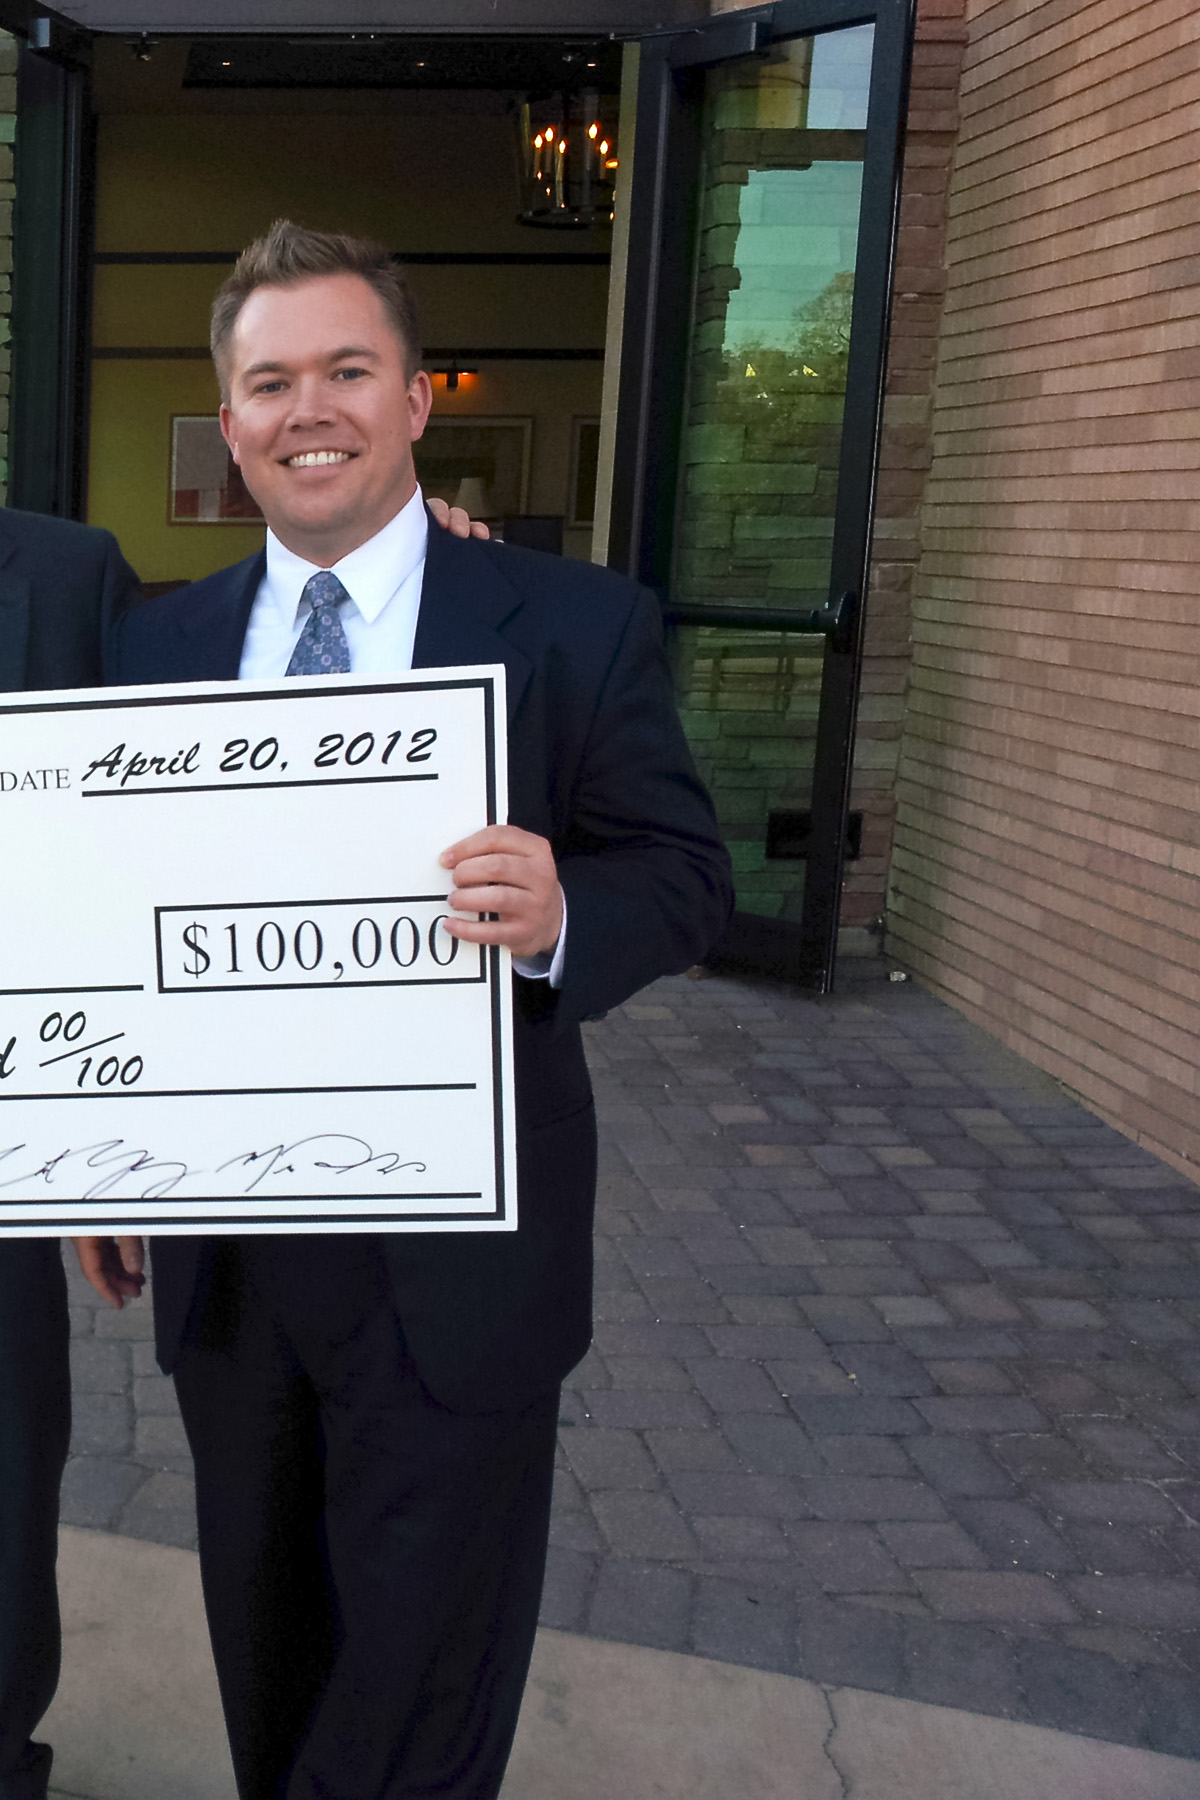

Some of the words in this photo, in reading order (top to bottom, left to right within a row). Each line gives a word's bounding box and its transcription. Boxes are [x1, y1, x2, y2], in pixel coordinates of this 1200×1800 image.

[0, 768, 70, 792] DATE
[81, 742, 200, 784] April
[219, 736, 289, 772] 20,
[313, 728, 438, 768] 2012
[181, 914, 460, 979] $100,000
